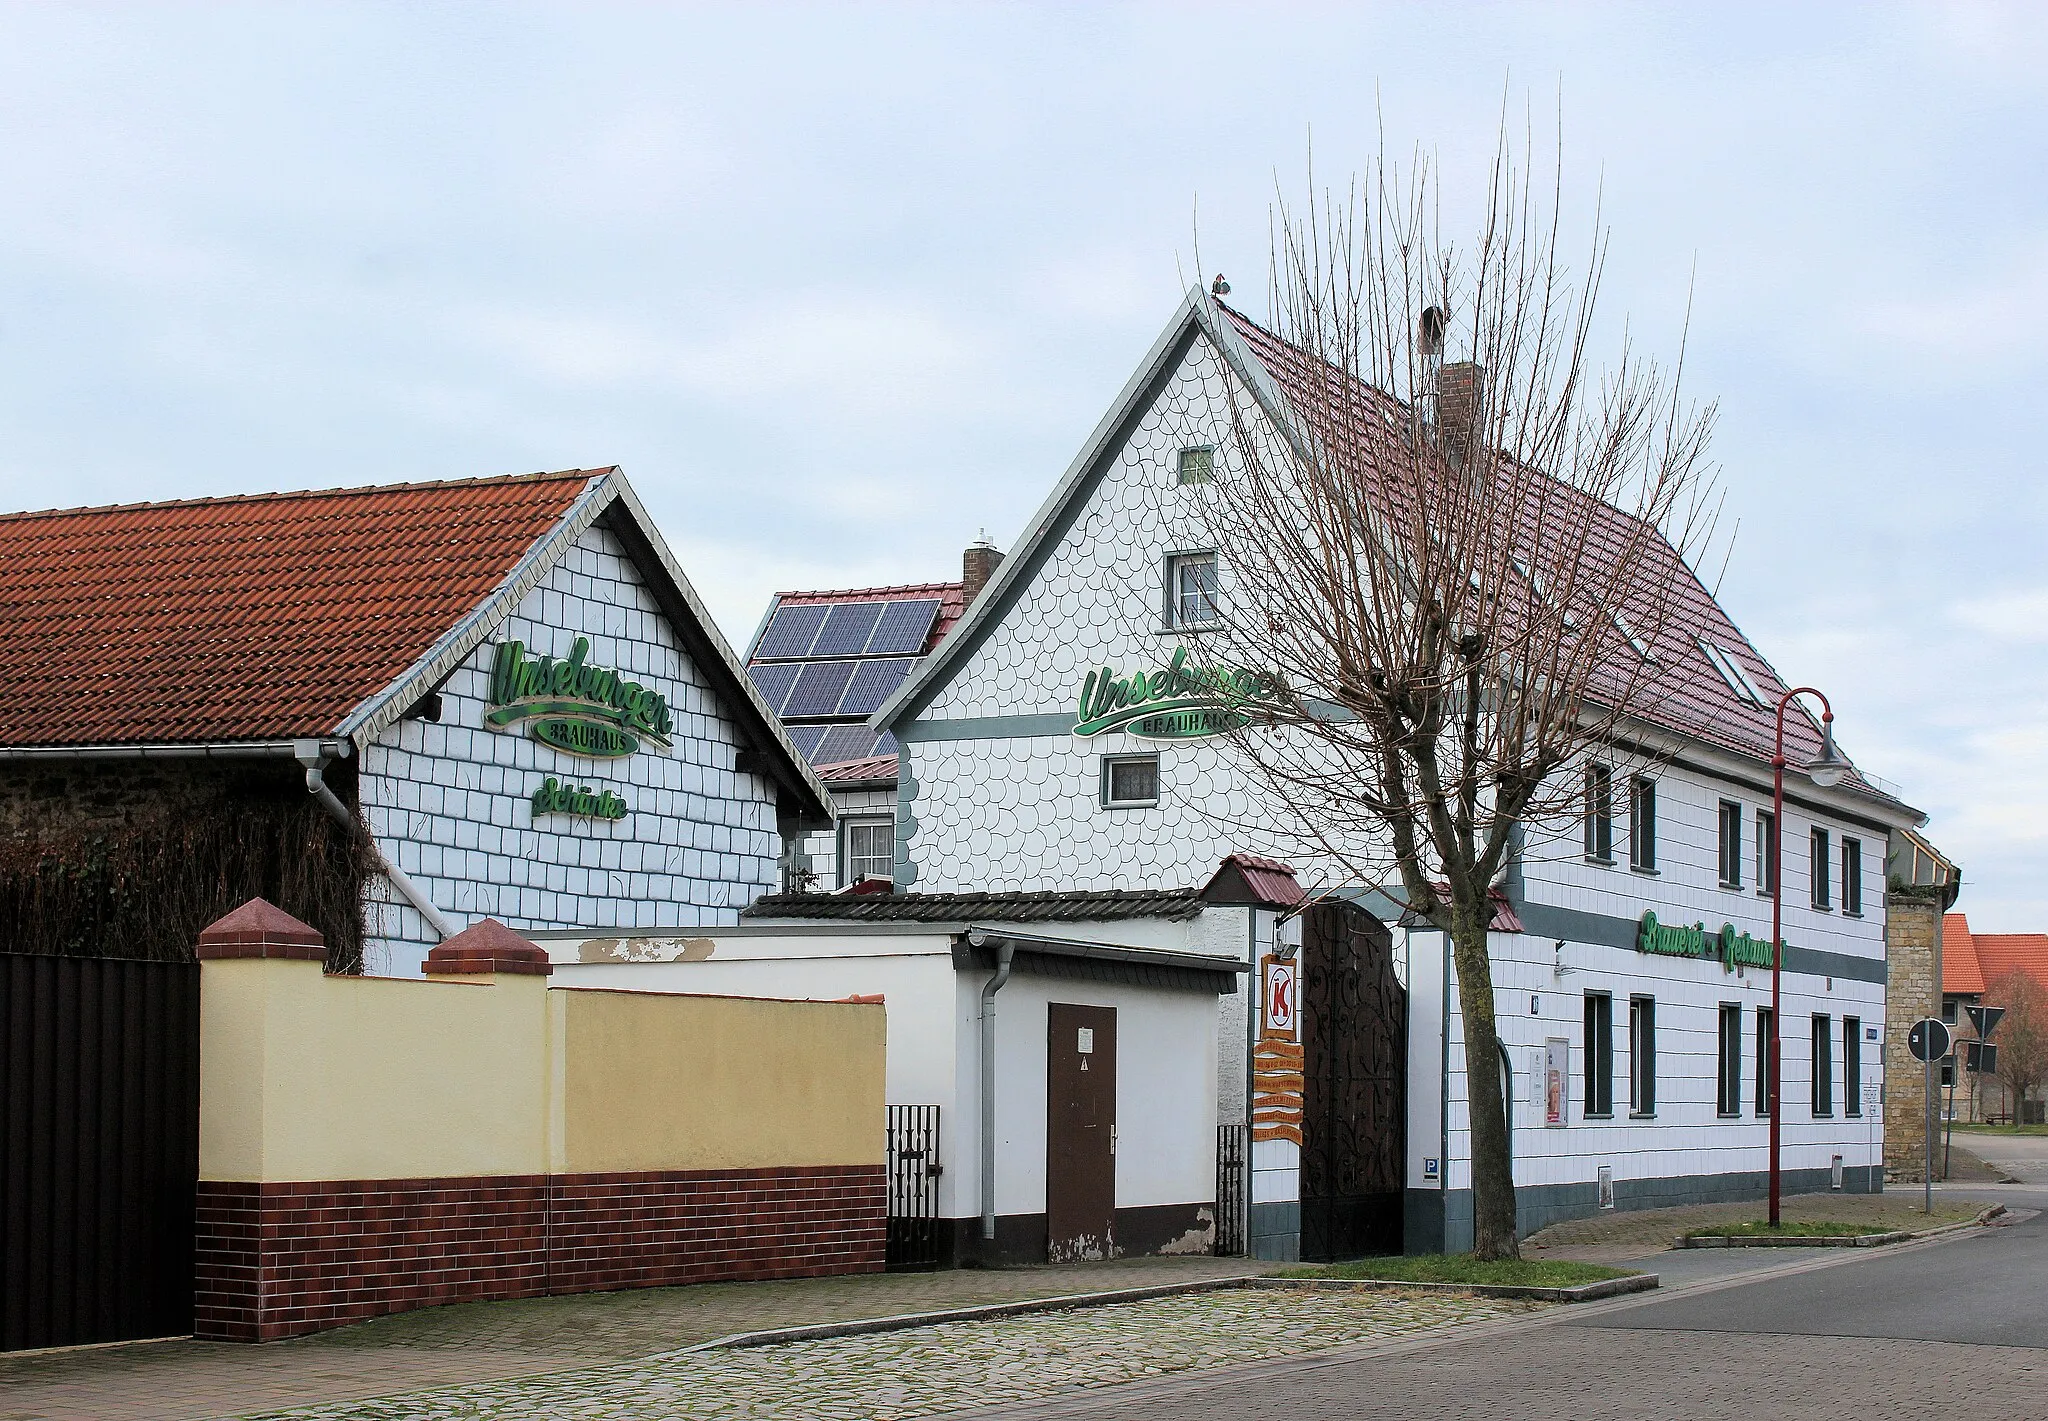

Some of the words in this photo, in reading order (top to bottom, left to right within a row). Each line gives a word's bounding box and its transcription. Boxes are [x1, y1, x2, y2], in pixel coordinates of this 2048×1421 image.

[490, 636, 674, 735] Unseburger
[549, 723, 628, 752] BRAUHAUS
[1143, 713, 1233, 733] BRAUHAUS
[532, 777, 629, 820] Schänke
[1640, 910, 1705, 954] Brauerei
[1427, 1160, 1436, 1172] P
